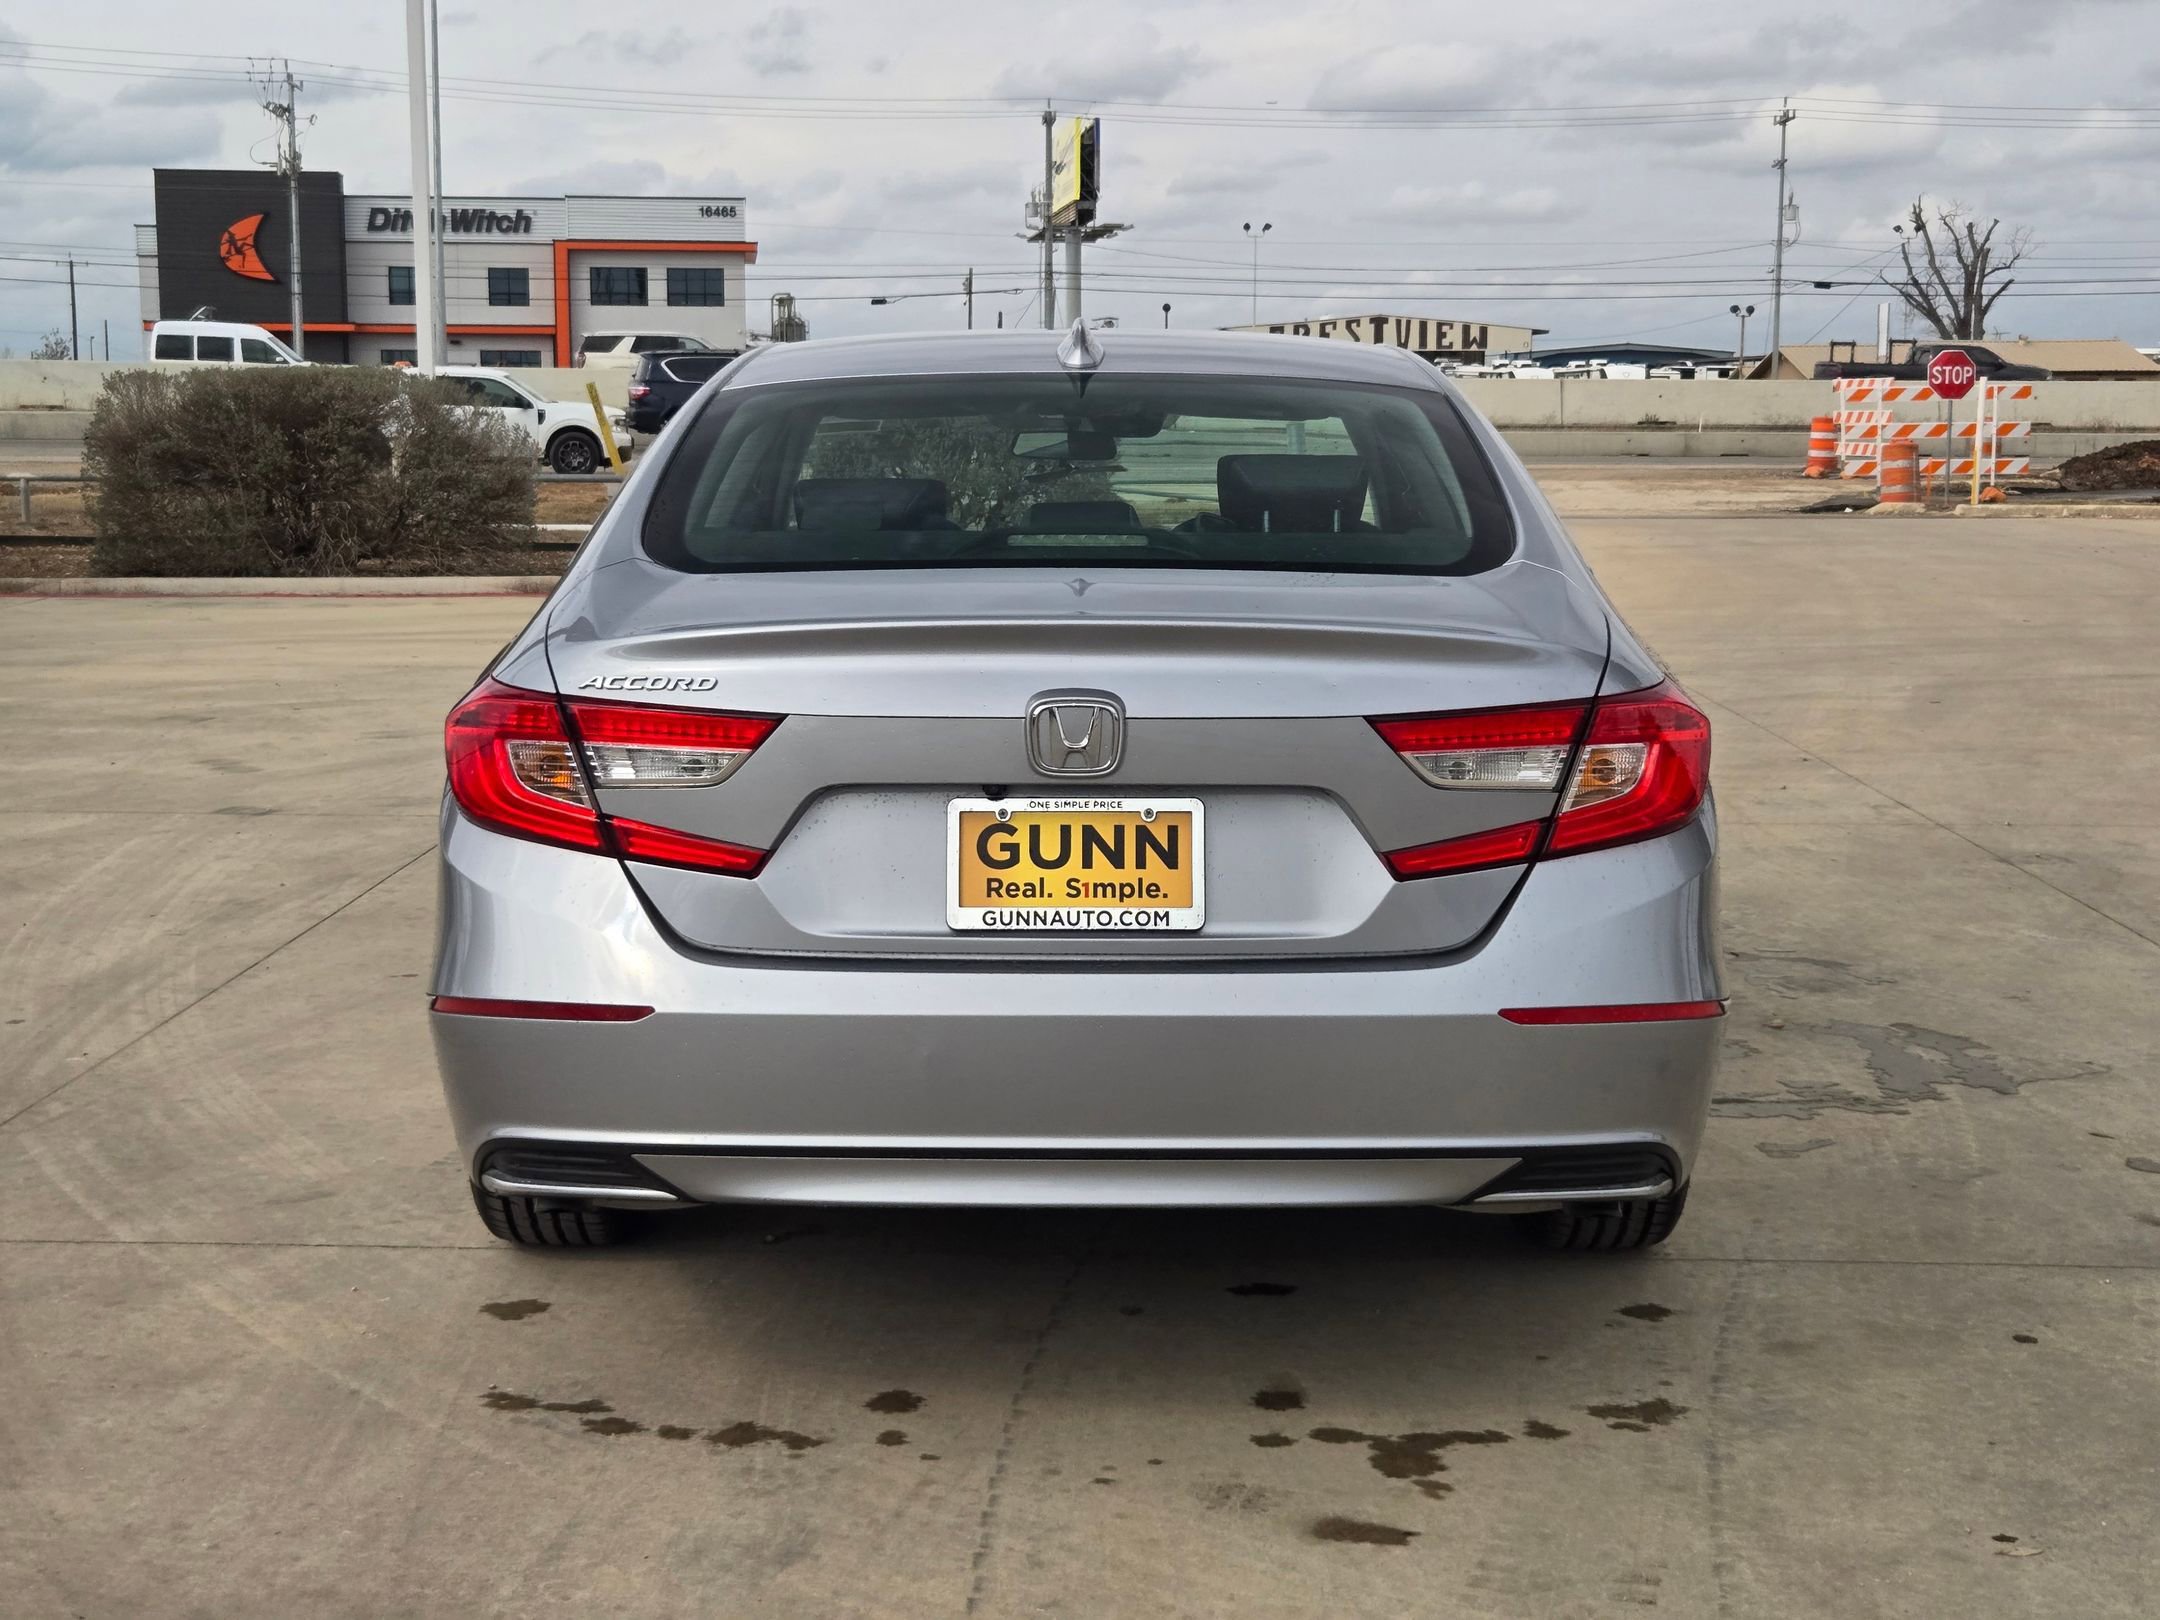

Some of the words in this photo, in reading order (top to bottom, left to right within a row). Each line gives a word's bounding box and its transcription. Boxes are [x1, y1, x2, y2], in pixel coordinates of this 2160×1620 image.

[367, 207, 447, 232] Dit
[451, 208, 532, 233] Witch
[699, 205, 737, 218] 16465
[1269, 317, 1488, 350] ESTVIEW
[1931, 366, 1973, 385] STOP
[578, 675, 718, 691] ACCORD
[1029, 800, 1050, 809] ONE
[1054, 800, 1090, 809] SIMPLE
[1093, 800, 1123, 810] PRICE
[976, 823, 1179, 871] GUNN
[986, 877, 1053, 899] Real.
[982, 910, 1170, 927] GUNNAUTO.COM
